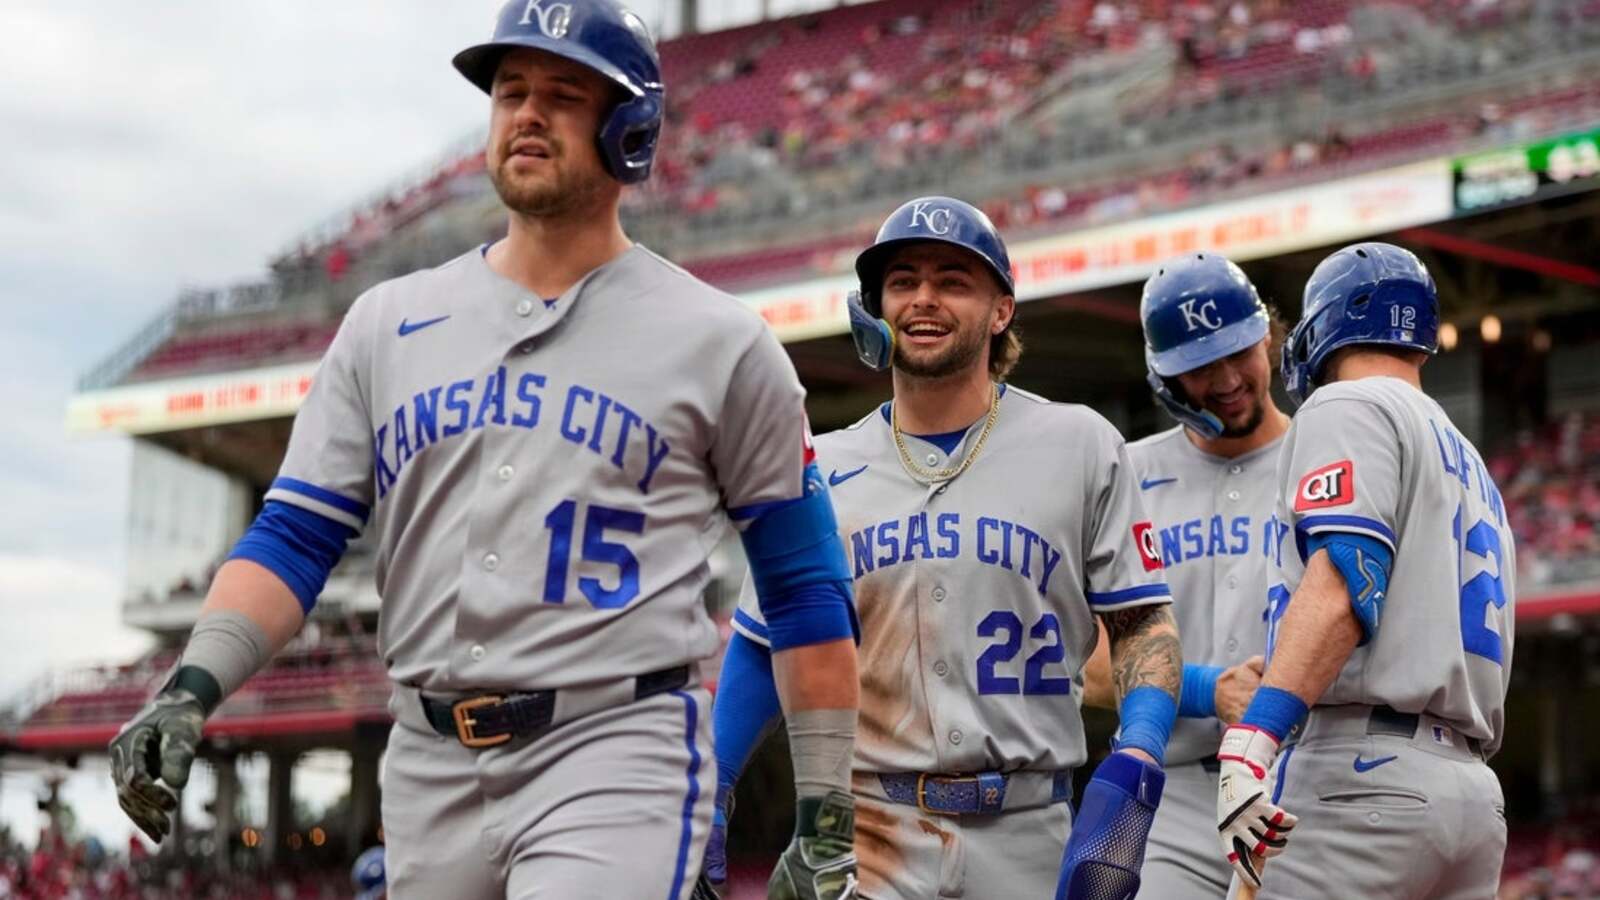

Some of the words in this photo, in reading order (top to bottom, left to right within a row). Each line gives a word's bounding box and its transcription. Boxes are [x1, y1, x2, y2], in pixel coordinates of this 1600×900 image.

[518, 0, 571, 39] KC
[907, 202, 950, 235] KC
[1177, 298, 1222, 331] KC
[1391, 304, 1416, 329] 12
[375, 366, 547, 498] KANSAS
[560, 385, 669, 495] CITY
[1302, 467, 1347, 501] QT
[543, 499, 646, 609] 15
[851, 511, 960, 580] NSAS
[977, 517, 1062, 598] CITY
[1159, 514, 1251, 569] NSAS
[1452, 503, 1506, 667] 12
[976, 611, 1070, 696] 22
